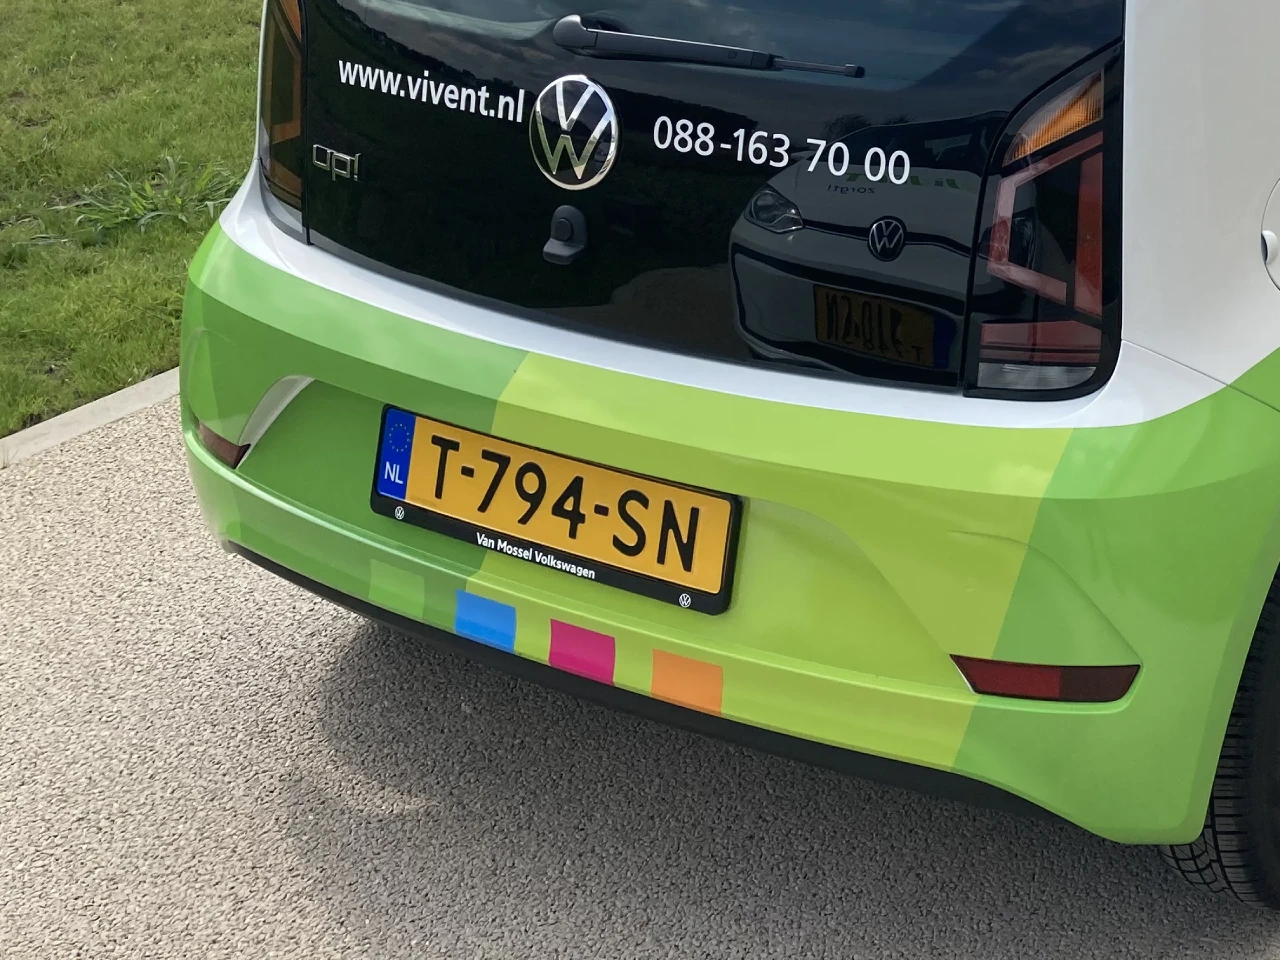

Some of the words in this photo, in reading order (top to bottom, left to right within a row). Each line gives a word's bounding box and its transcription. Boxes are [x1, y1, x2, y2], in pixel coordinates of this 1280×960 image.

[338, 60, 526, 123] www.vivent.nl
[653, 116, 791, 168] 088-163
[806, 138, 850, 177] 70
[864, 147, 911, 185] 00
[384, 461, 404, 484] NL
[431, 434, 700, 573] T-794-SN
[476, 532, 495, 549] Van
[497, 539, 533, 561] Mossel
[534, 550, 596, 580] Volkswagen
